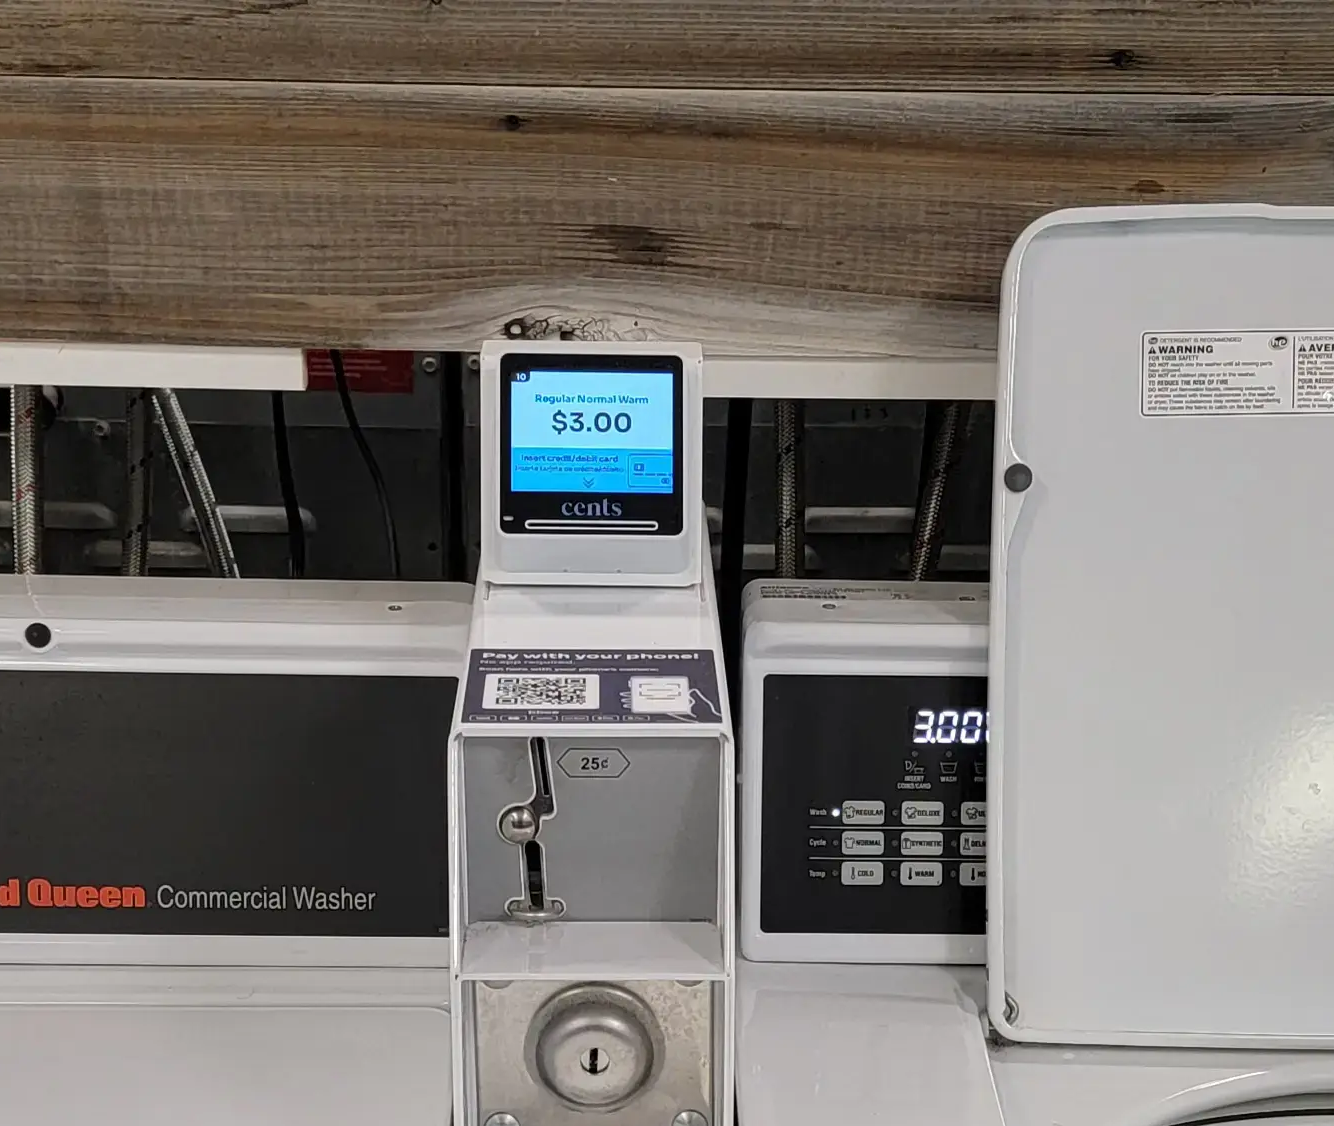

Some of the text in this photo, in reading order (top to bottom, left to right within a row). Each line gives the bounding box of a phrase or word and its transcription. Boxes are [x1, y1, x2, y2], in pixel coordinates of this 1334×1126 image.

[1158, 345, 1214, 354] WARNING
[516, 373, 527, 381] 10
[535, 394, 649, 405] Regular Normal Warm
[552, 410, 632, 435] $3.00
[599, 455, 619, 463] card
[561, 498, 623, 517] cents
[483, 652, 699, 661] Pay with your phone!
[580, 757, 609, 770] 25¢
[809, 808, 827, 816] Wash
[855, 809, 884, 817] REGULAR
[809, 839, 827, 847] Cycle
[911, 840, 943, 848] SYNTHETIC
[809, 870, 826, 879] Temp
[27, 878, 147, 908] Queen
[156, 884, 287, 910] Commercial
[292, 887, 378, 911] Washer
